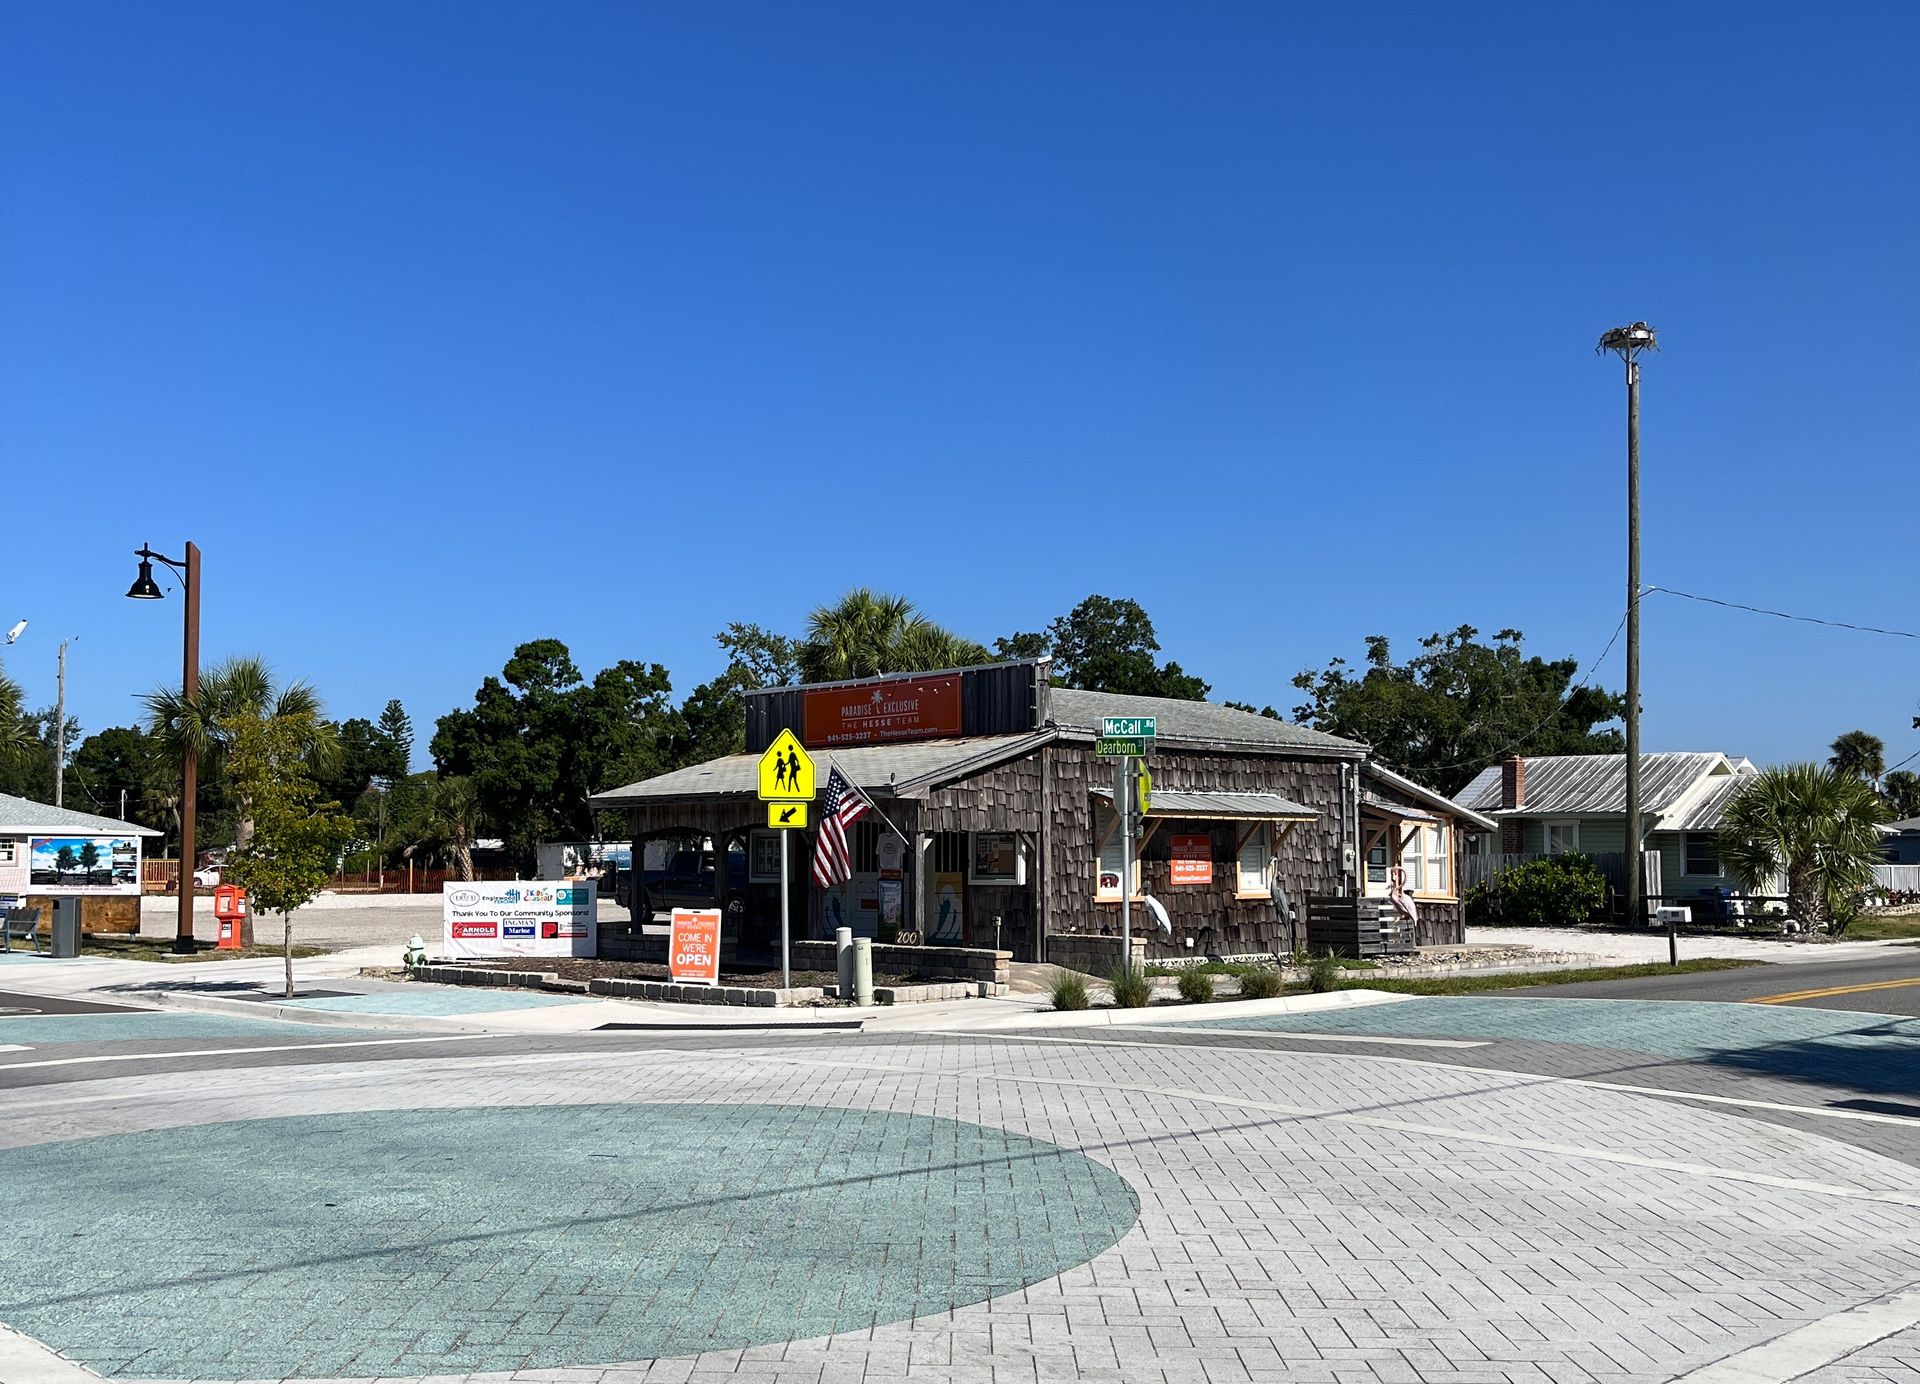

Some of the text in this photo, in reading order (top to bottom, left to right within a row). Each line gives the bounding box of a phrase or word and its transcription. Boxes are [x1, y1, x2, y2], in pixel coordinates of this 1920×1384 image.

[841, 698, 919, 717] PARADISE EXCLUSIVE
[842, 715, 920, 730] THE HESSE TEAM
[1105, 719, 1141, 734] McCall
[879, 727, 938, 738] TheHesseTeam.com
[1097, 739, 1137, 754] Dearborn
[514, 910, 554, 918] Community
[554, 909, 590, 918] Sponsors!
[678, 932, 713, 944] COME IN
[896, 931, 917, 945] 200
[676, 953, 712, 966] OPEN
